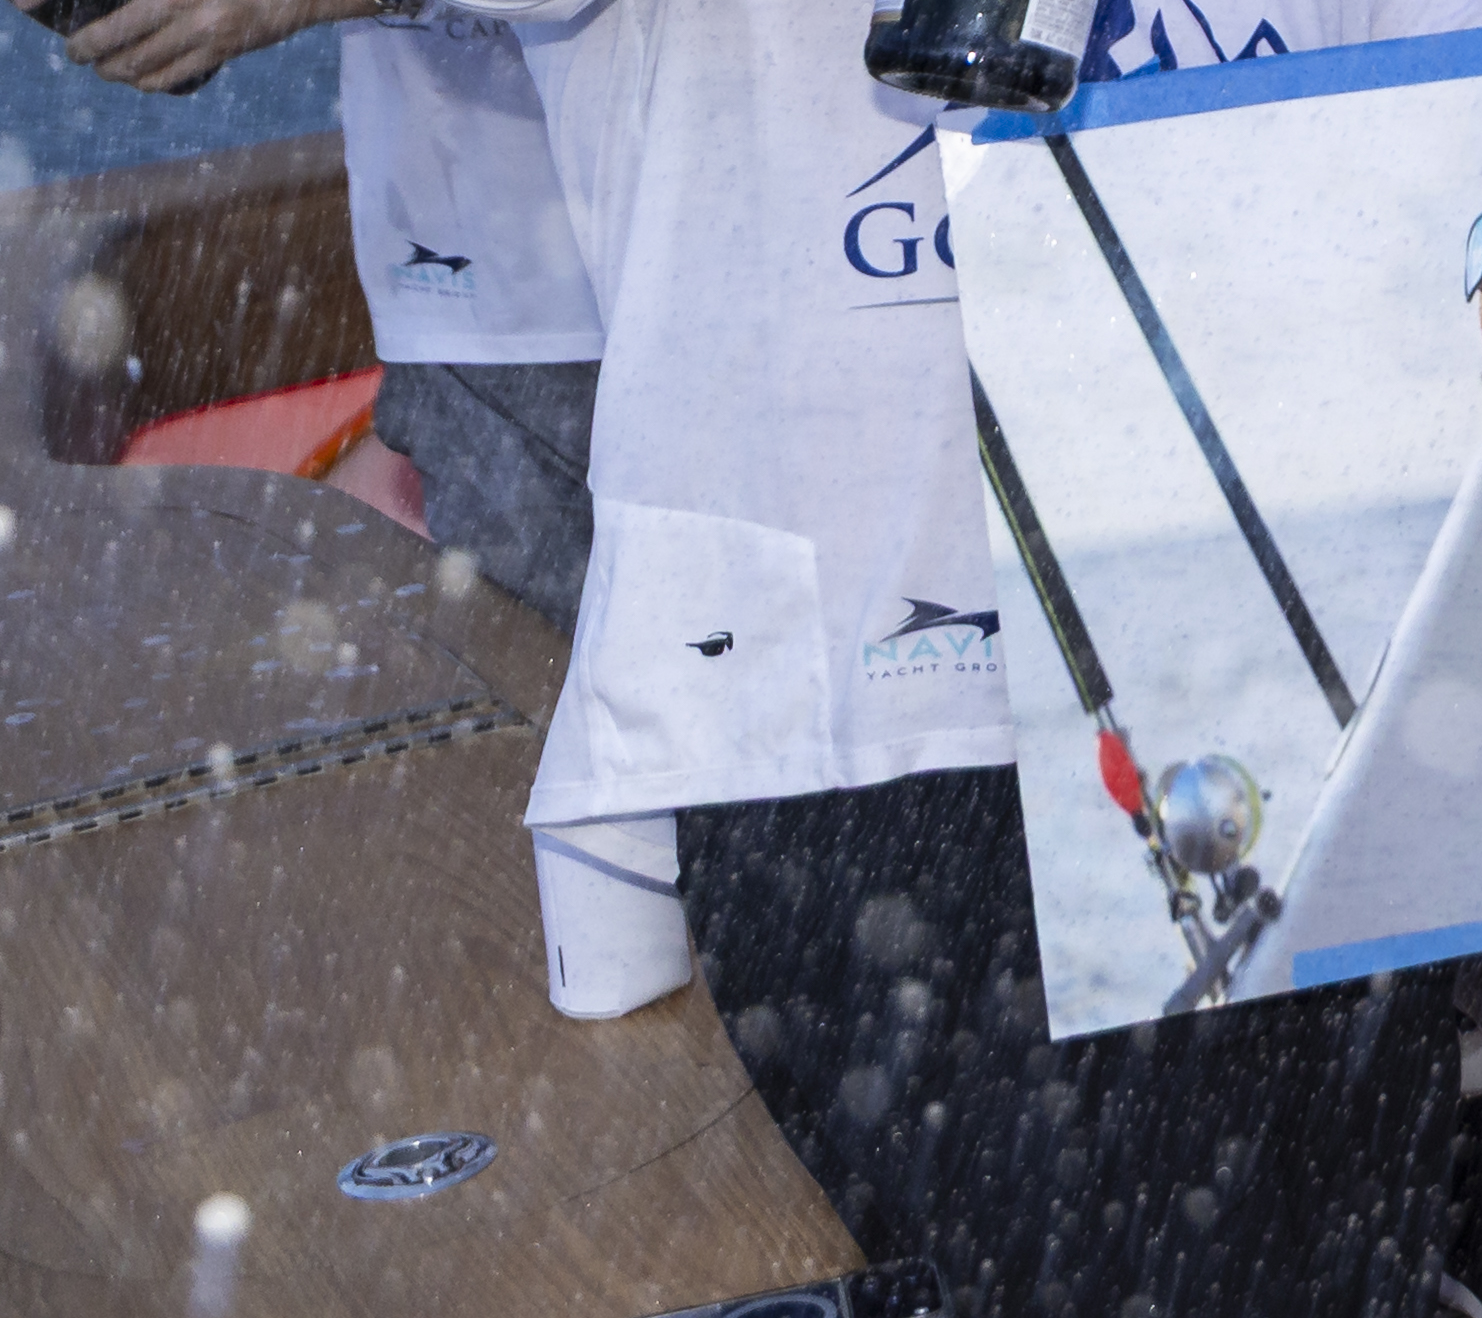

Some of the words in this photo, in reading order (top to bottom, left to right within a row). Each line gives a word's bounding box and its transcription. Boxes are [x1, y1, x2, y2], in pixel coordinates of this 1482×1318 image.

[863, 631, 993, 667] NAVI
[866, 662, 940, 680] YACHT
[954, 661, 998, 674] GRO
